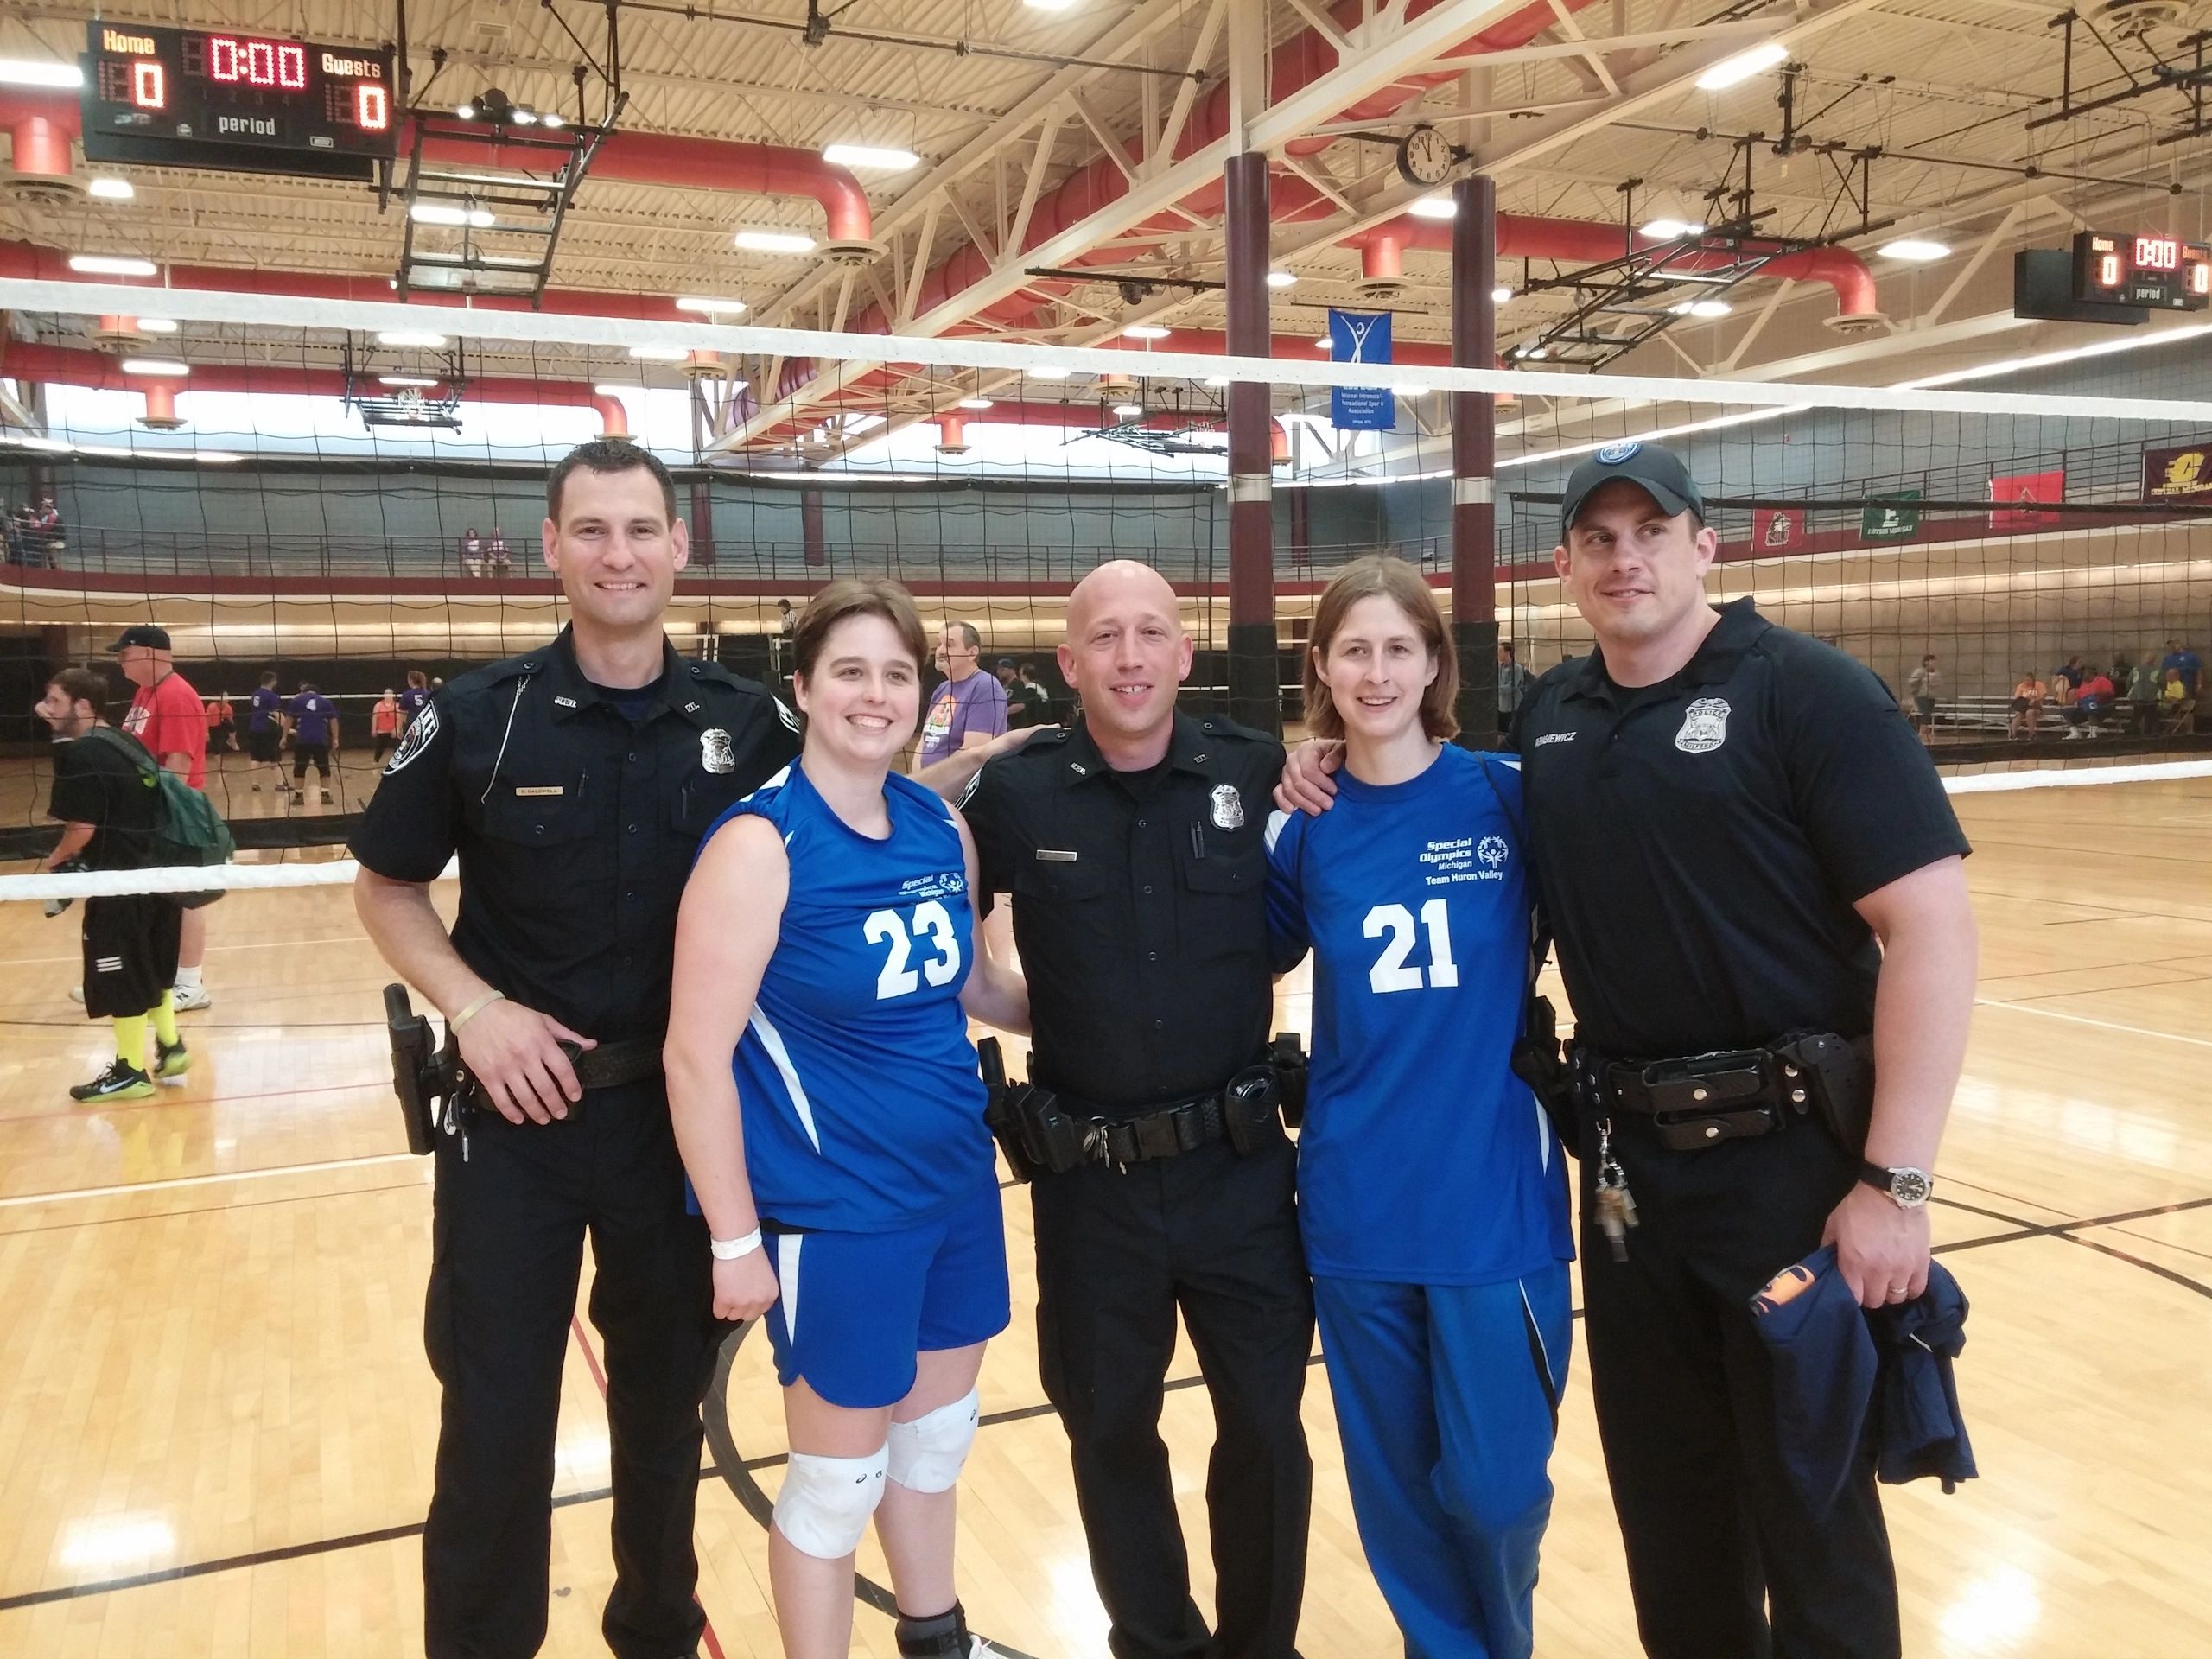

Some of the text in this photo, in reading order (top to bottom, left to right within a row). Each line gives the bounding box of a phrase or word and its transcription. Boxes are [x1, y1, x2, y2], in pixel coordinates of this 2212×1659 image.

[104, 29, 156, 54] Home
[212, 37, 305, 88] 0:00
[322, 53, 381, 77] Guests
[135, 62, 164, 108] 0
[359, 85, 386, 129] 0
[219, 115, 276, 136] period
[2092, 237, 2114, 252] Home
[2102, 256, 2117, 285] 0
[2195, 264, 2209, 293] 0
[2136, 287, 2161, 300] period
[306, 698, 316, 711] 4
[414, 694, 423, 706] 5
[1427, 837, 1472, 852] Special
[1419, 849, 1472, 864] Olympics
[1438, 861, 1472, 871] Michigan
[901, 874, 934, 890] Special
[1425, 869, 1503, 886] Team Huron Valley
[862, 899, 961, 1001] 23
[1362, 898, 1459, 994] 21
